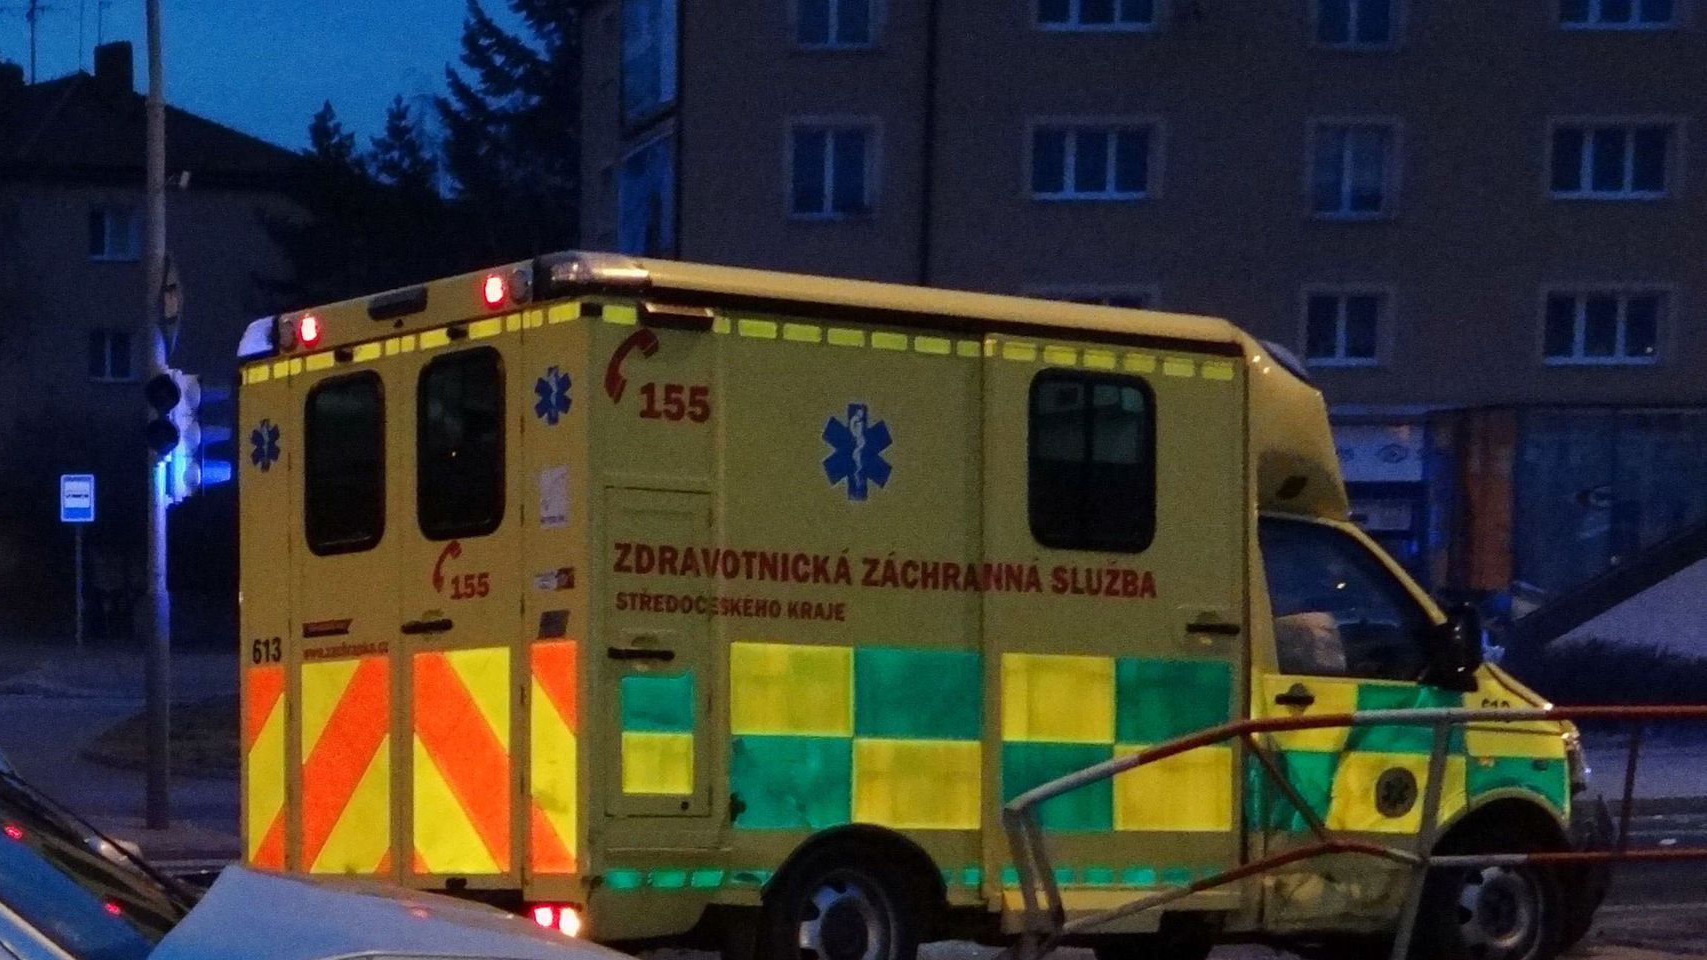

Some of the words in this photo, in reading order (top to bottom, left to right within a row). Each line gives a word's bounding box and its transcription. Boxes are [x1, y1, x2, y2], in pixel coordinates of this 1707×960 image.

[639, 382, 710, 423] 155
[612, 542, 853, 586] ZDRAVOTNICKÁ
[860, 551, 1044, 594] ZÁCHRANNÁ
[1051, 559, 1158, 598] SLUŽBA
[449, 572, 491, 600] 155
[787, 601, 846, 621] KRAJE
[252, 636, 282, 665] 613
